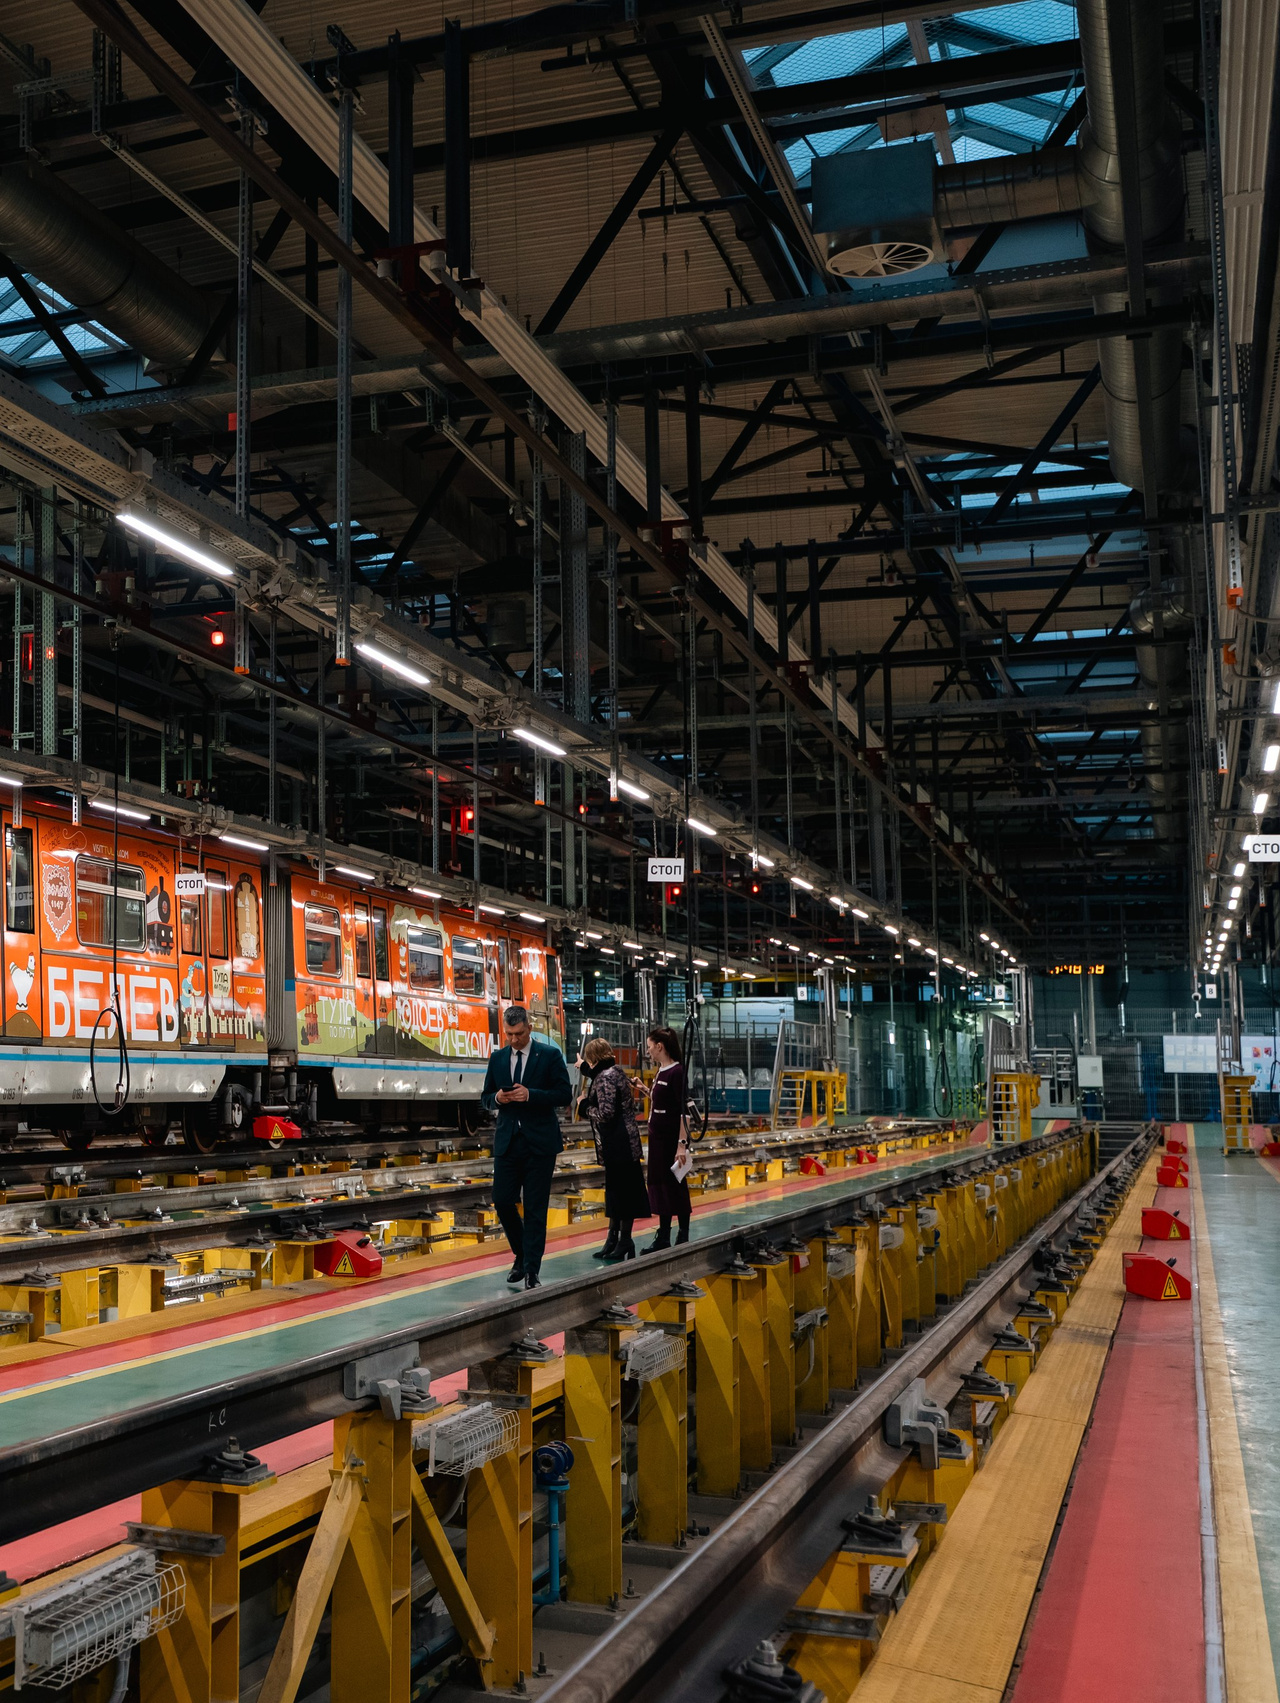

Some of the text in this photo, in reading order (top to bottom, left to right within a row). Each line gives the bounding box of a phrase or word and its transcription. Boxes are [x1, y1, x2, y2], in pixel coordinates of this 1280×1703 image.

[649, 863, 682, 876] СТОП
[177, 879, 203, 889] СТОП
[47, 964, 180, 1042] БЕЛЁВ
